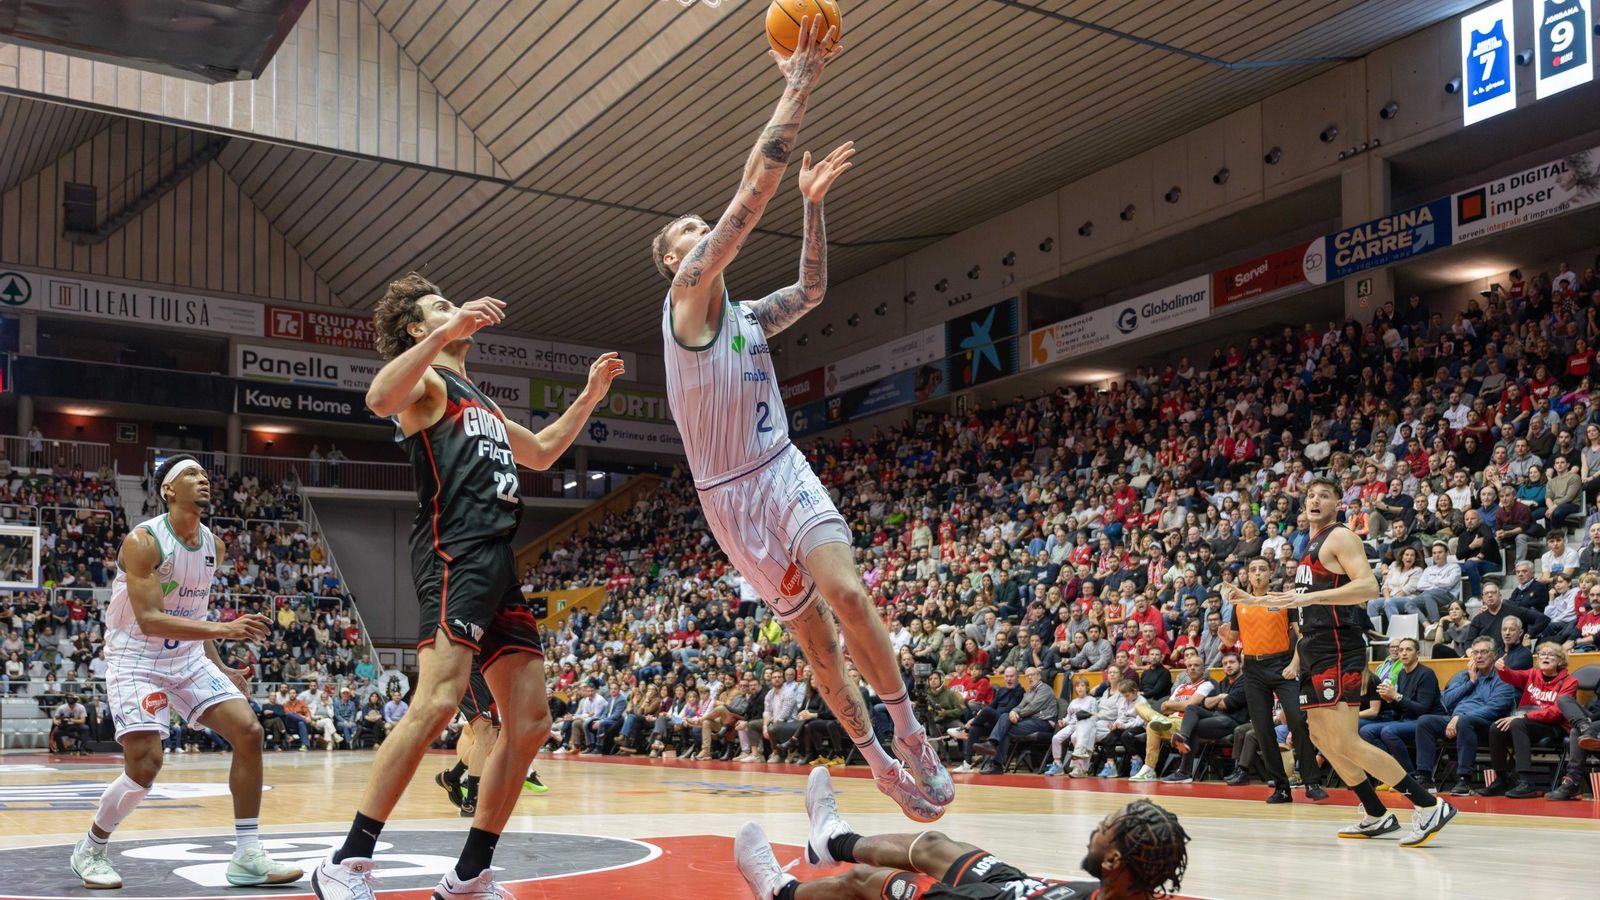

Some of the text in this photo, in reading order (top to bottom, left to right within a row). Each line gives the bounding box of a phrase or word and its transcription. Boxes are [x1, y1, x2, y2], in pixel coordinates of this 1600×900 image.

[1550, 20, 1575, 53] 9
[1479, 50, 1496, 82] 7
[1490, 161, 1569, 196] La DIGITAL
[1491, 186, 1555, 217] impser
[1334, 206, 1434, 250] CALSINA
[1458, 228, 1486, 242] serveis
[1234, 259, 1269, 287] Servei
[84, 287, 140, 318] LLEAL
[149, 295, 210, 326] TULSÀ
[1141, 290, 1207, 318] Globalimar
[242, 349, 339, 380] Panella
[245, 388, 352, 415] Kave Home
[755, 401, 773, 433] 2
[613, 429, 645, 441] Pirineu
[647, 433, 658, 442] de
[494, 471, 519, 504] 22
